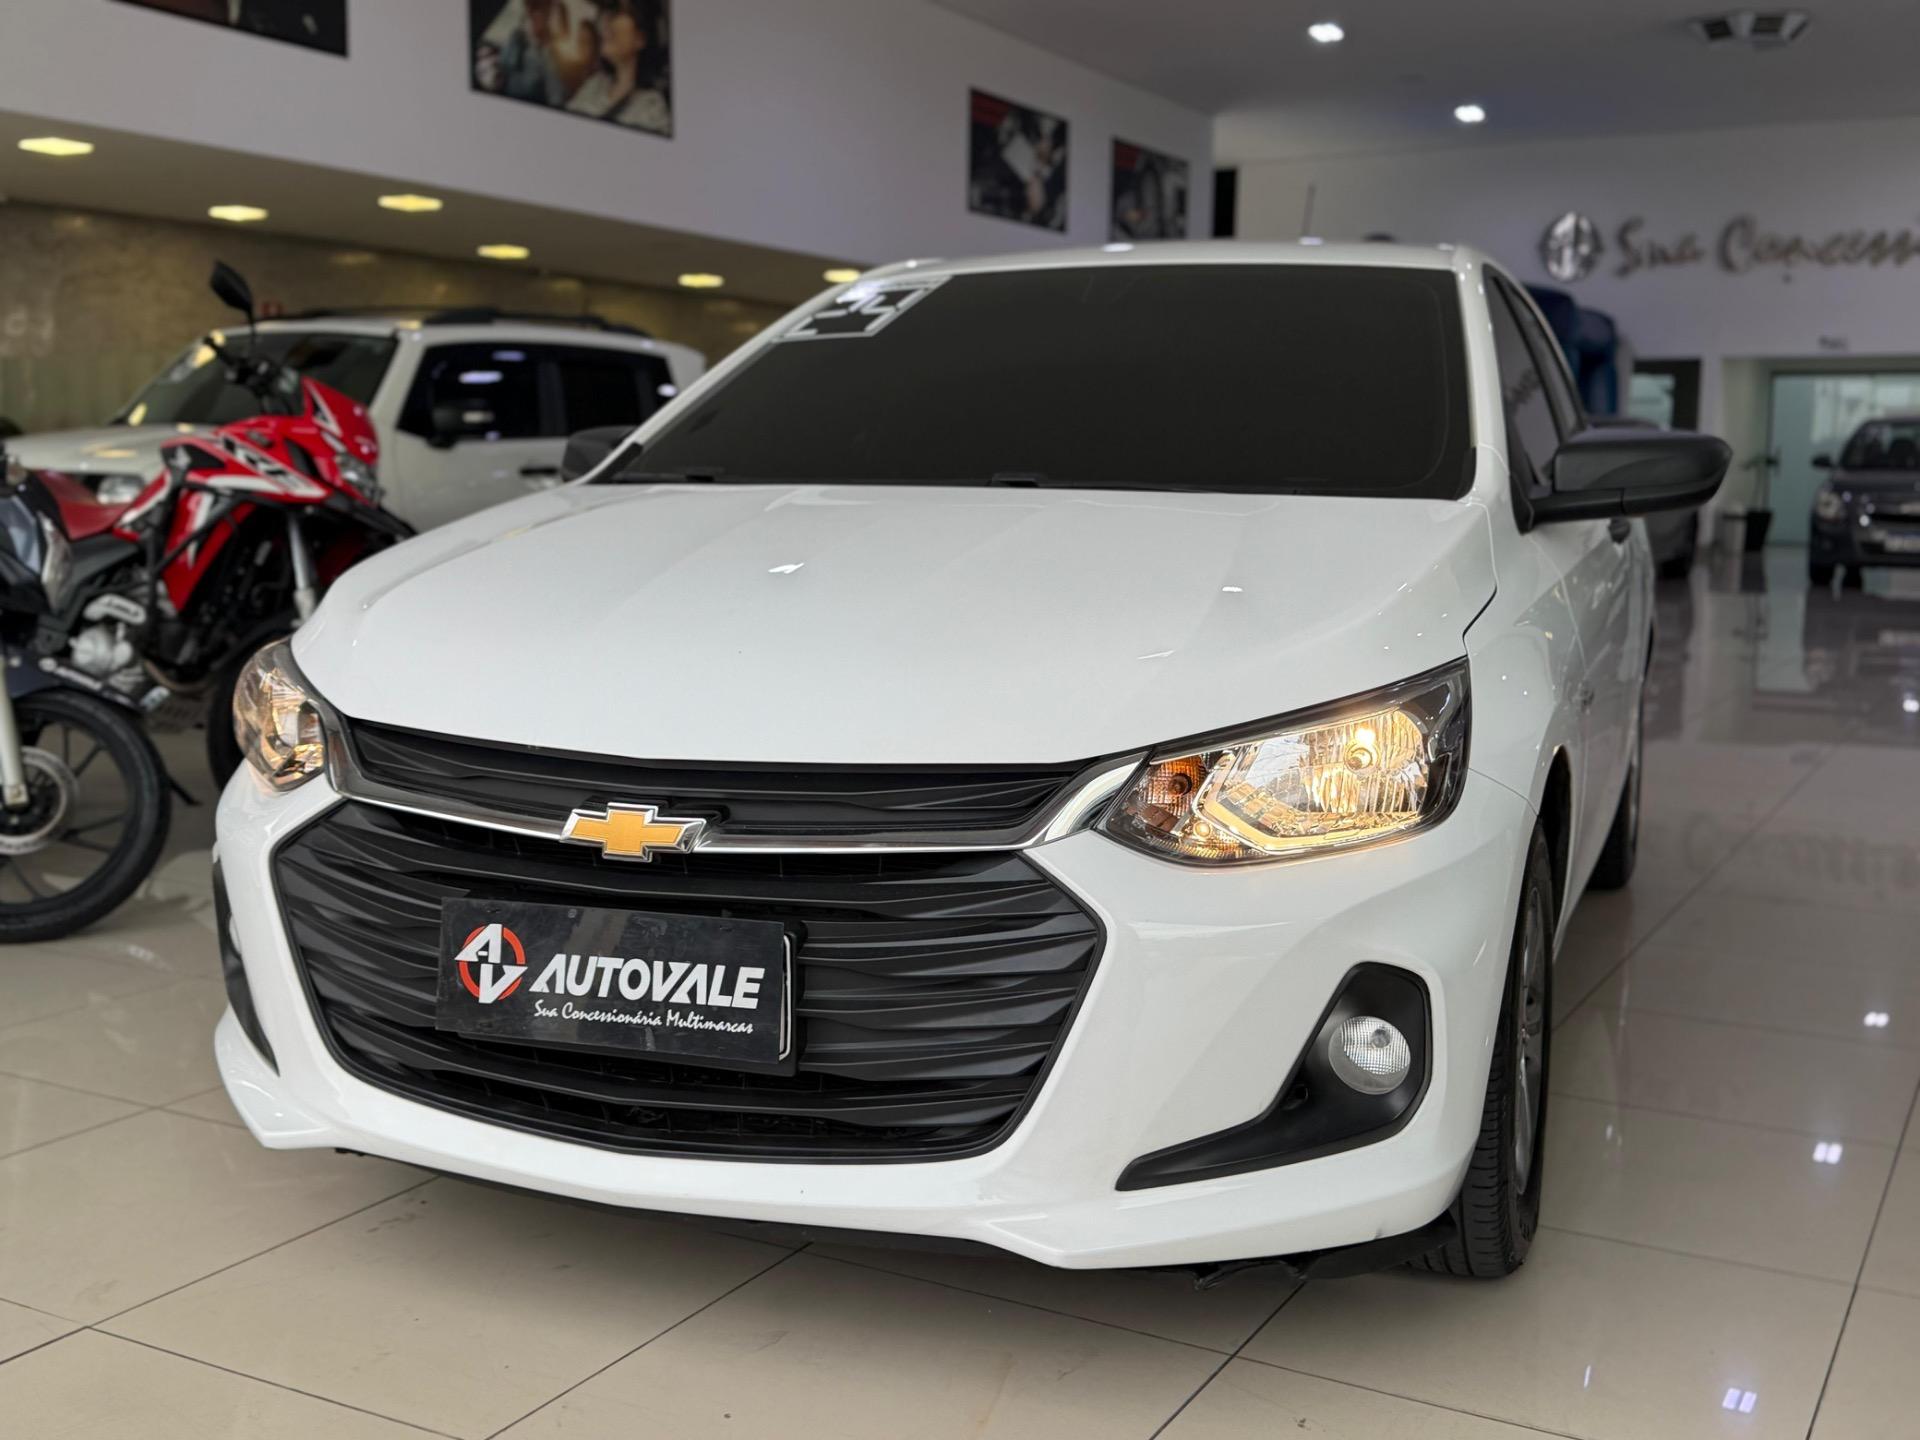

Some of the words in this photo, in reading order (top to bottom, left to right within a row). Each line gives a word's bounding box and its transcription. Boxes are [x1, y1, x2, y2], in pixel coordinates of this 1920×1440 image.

[529, 954, 765, 1009] AUTOVALE
[534, 999, 558, 1018] Sua
[561, 1001, 662, 1026] Concessionária
[665, 1008, 754, 1034] Multimarcas
